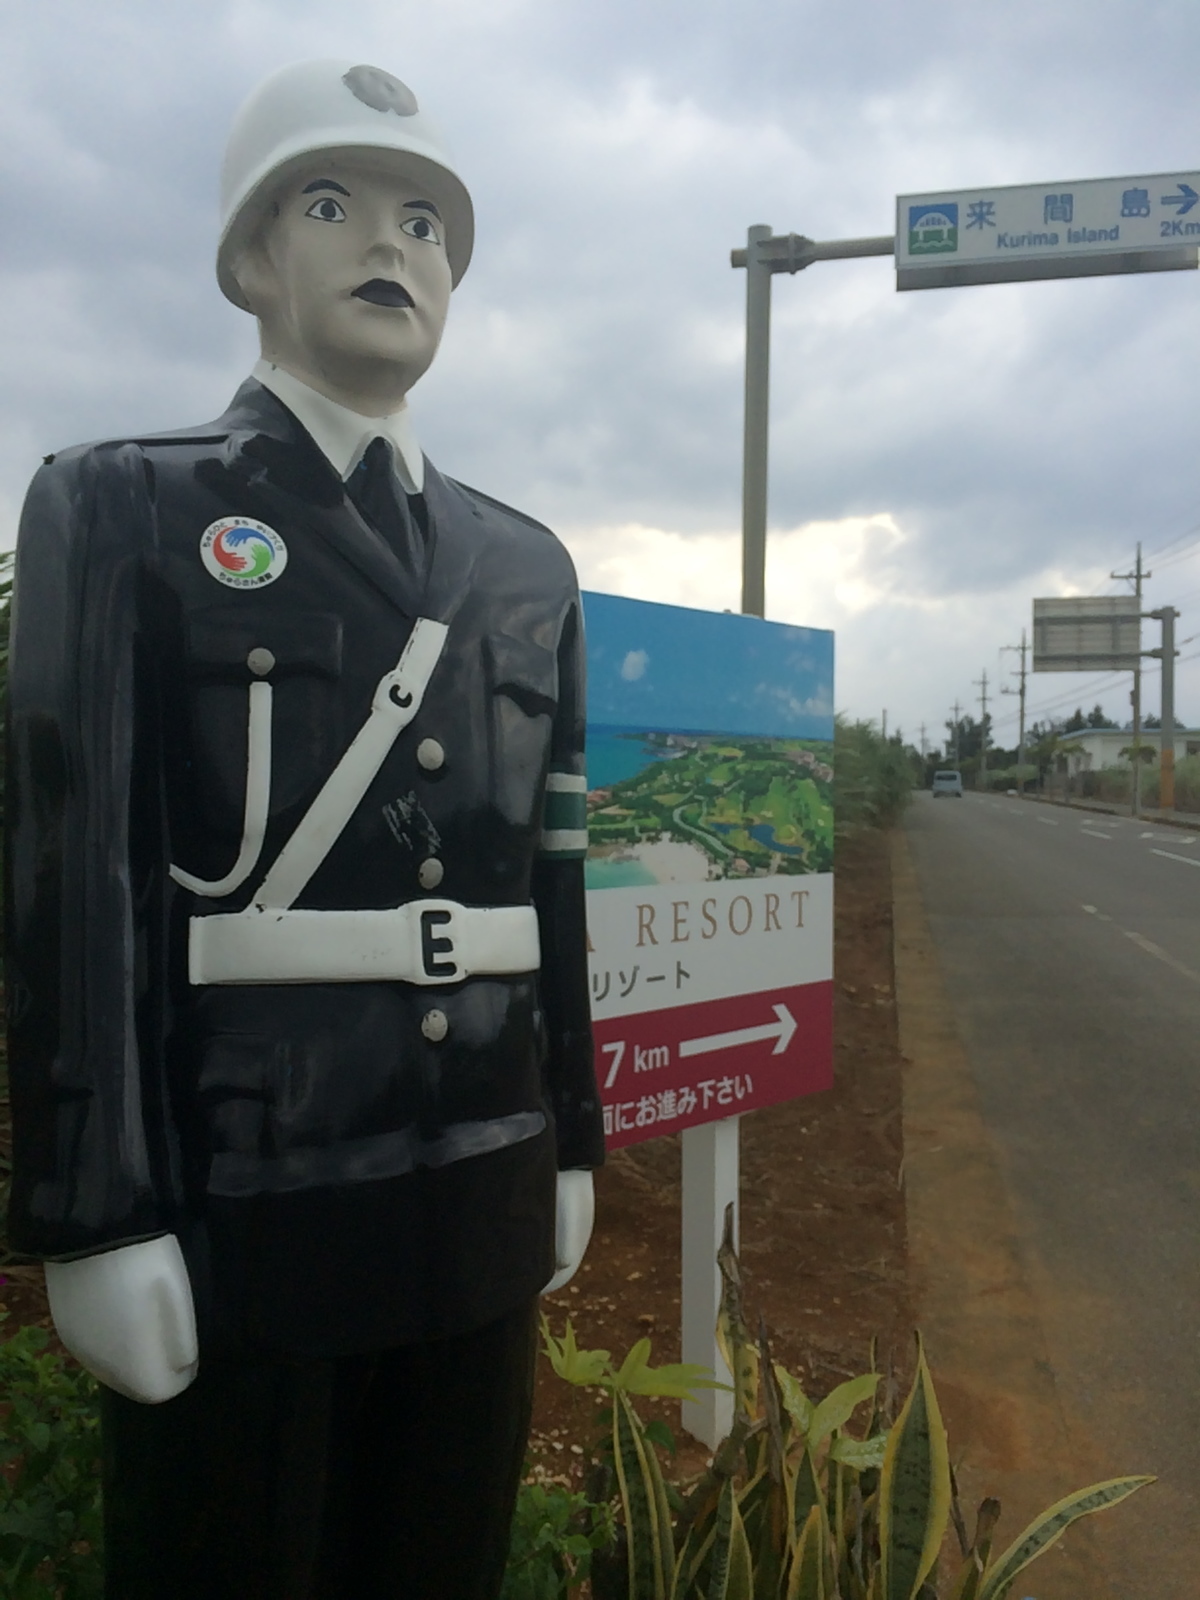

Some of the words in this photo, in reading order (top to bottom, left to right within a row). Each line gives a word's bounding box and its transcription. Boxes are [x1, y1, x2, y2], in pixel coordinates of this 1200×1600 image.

[965, 187, 1151, 231] 来間島
[997, 230, 1059, 250] Kurima
[1067, 224, 1120, 245] Island
[635, 890, 810, 948] RESORT
[420, 909, 457, 977] E
[592, 960, 691, 1002] リゾート
